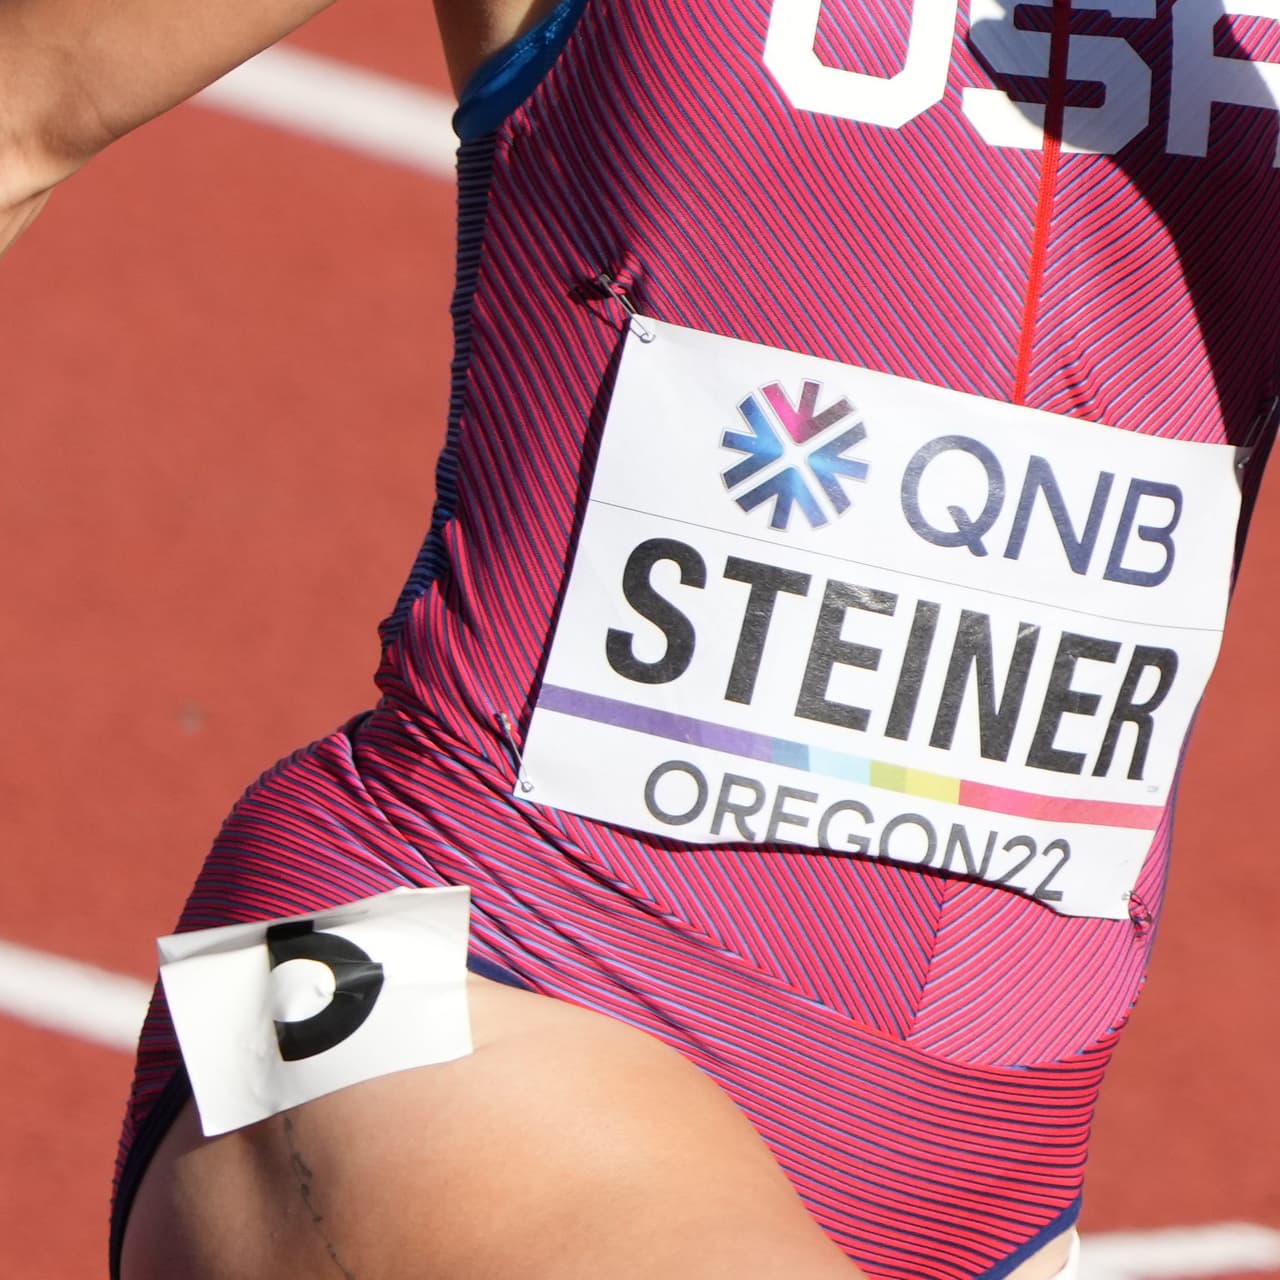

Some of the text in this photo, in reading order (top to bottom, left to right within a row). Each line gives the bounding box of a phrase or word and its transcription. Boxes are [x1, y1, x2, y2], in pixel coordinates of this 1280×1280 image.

[899, 434, 1184, 589] QNB
[605, 536, 1179, 782] STEINER
[643, 759, 1072, 902] OREGON22
